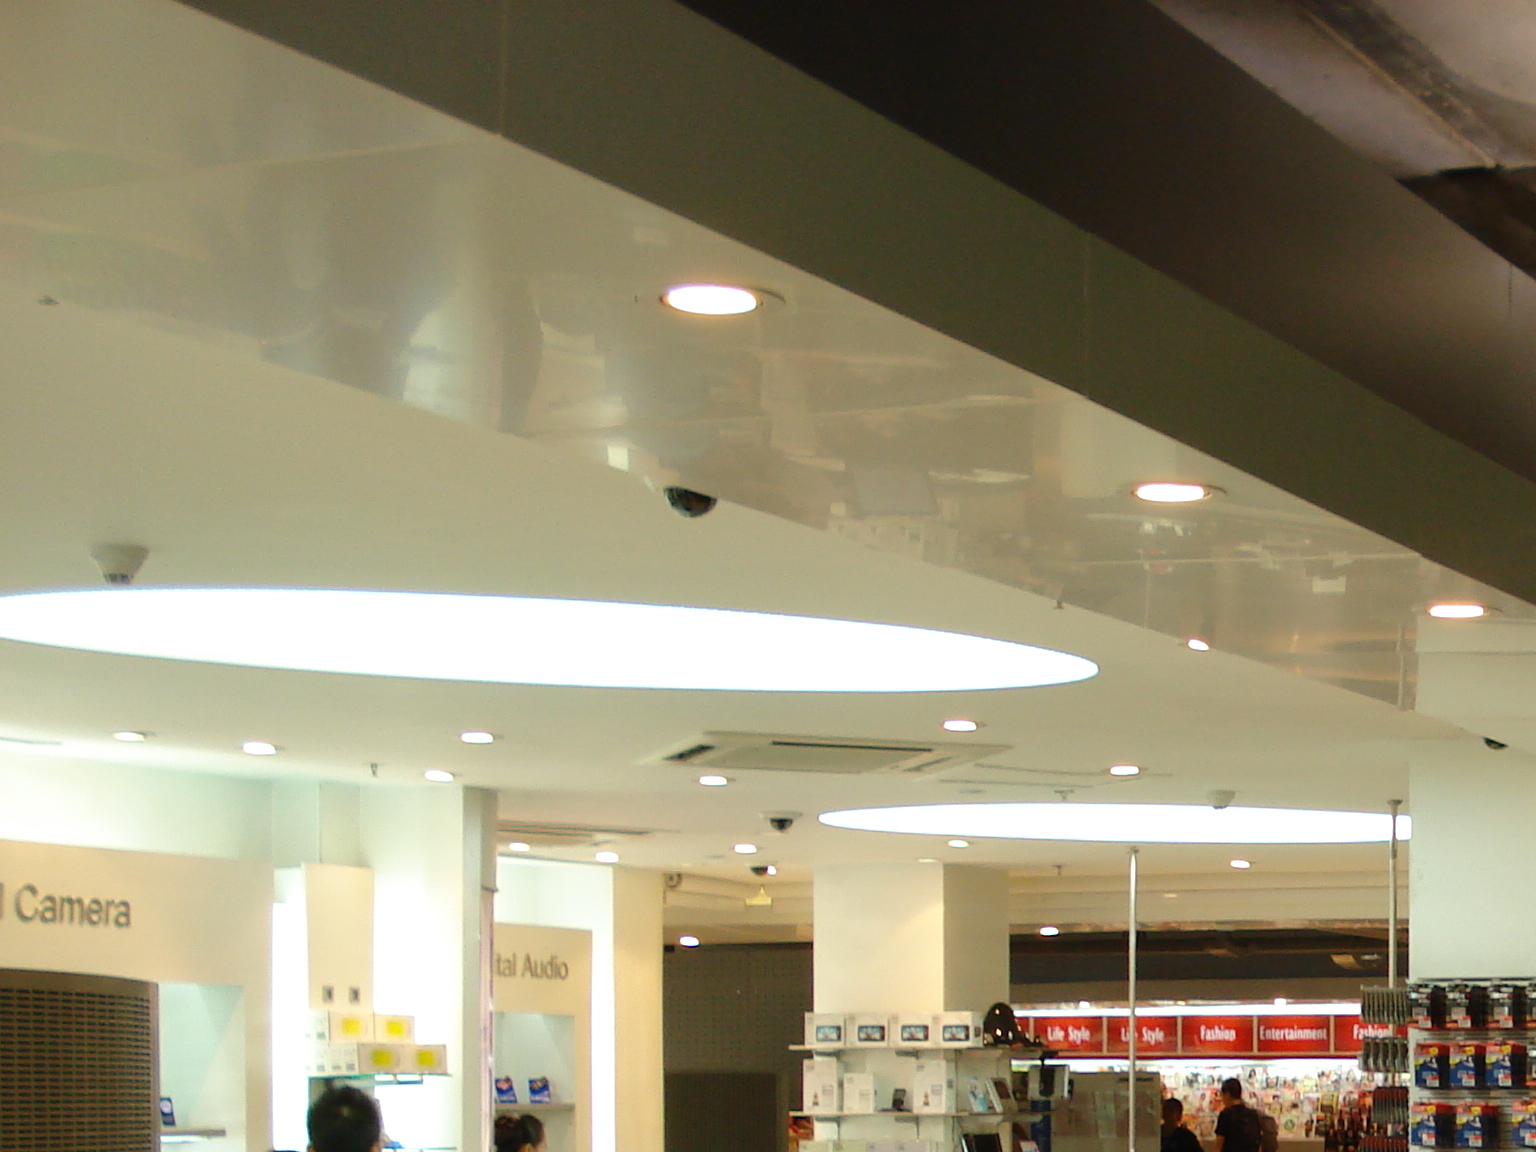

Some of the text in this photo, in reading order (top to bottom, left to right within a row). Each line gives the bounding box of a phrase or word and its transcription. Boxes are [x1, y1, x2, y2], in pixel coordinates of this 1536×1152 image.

[14, 883, 132, 929] Camera
[521, 952, 569, 981] Audio
[1047, 1025, 1091, 1045] Life Style
[1142, 1026, 1164, 1045] Style
[1200, 1025, 1236, 1042] Fashion
[1259, 1025, 1328, 1041] Entertainment
